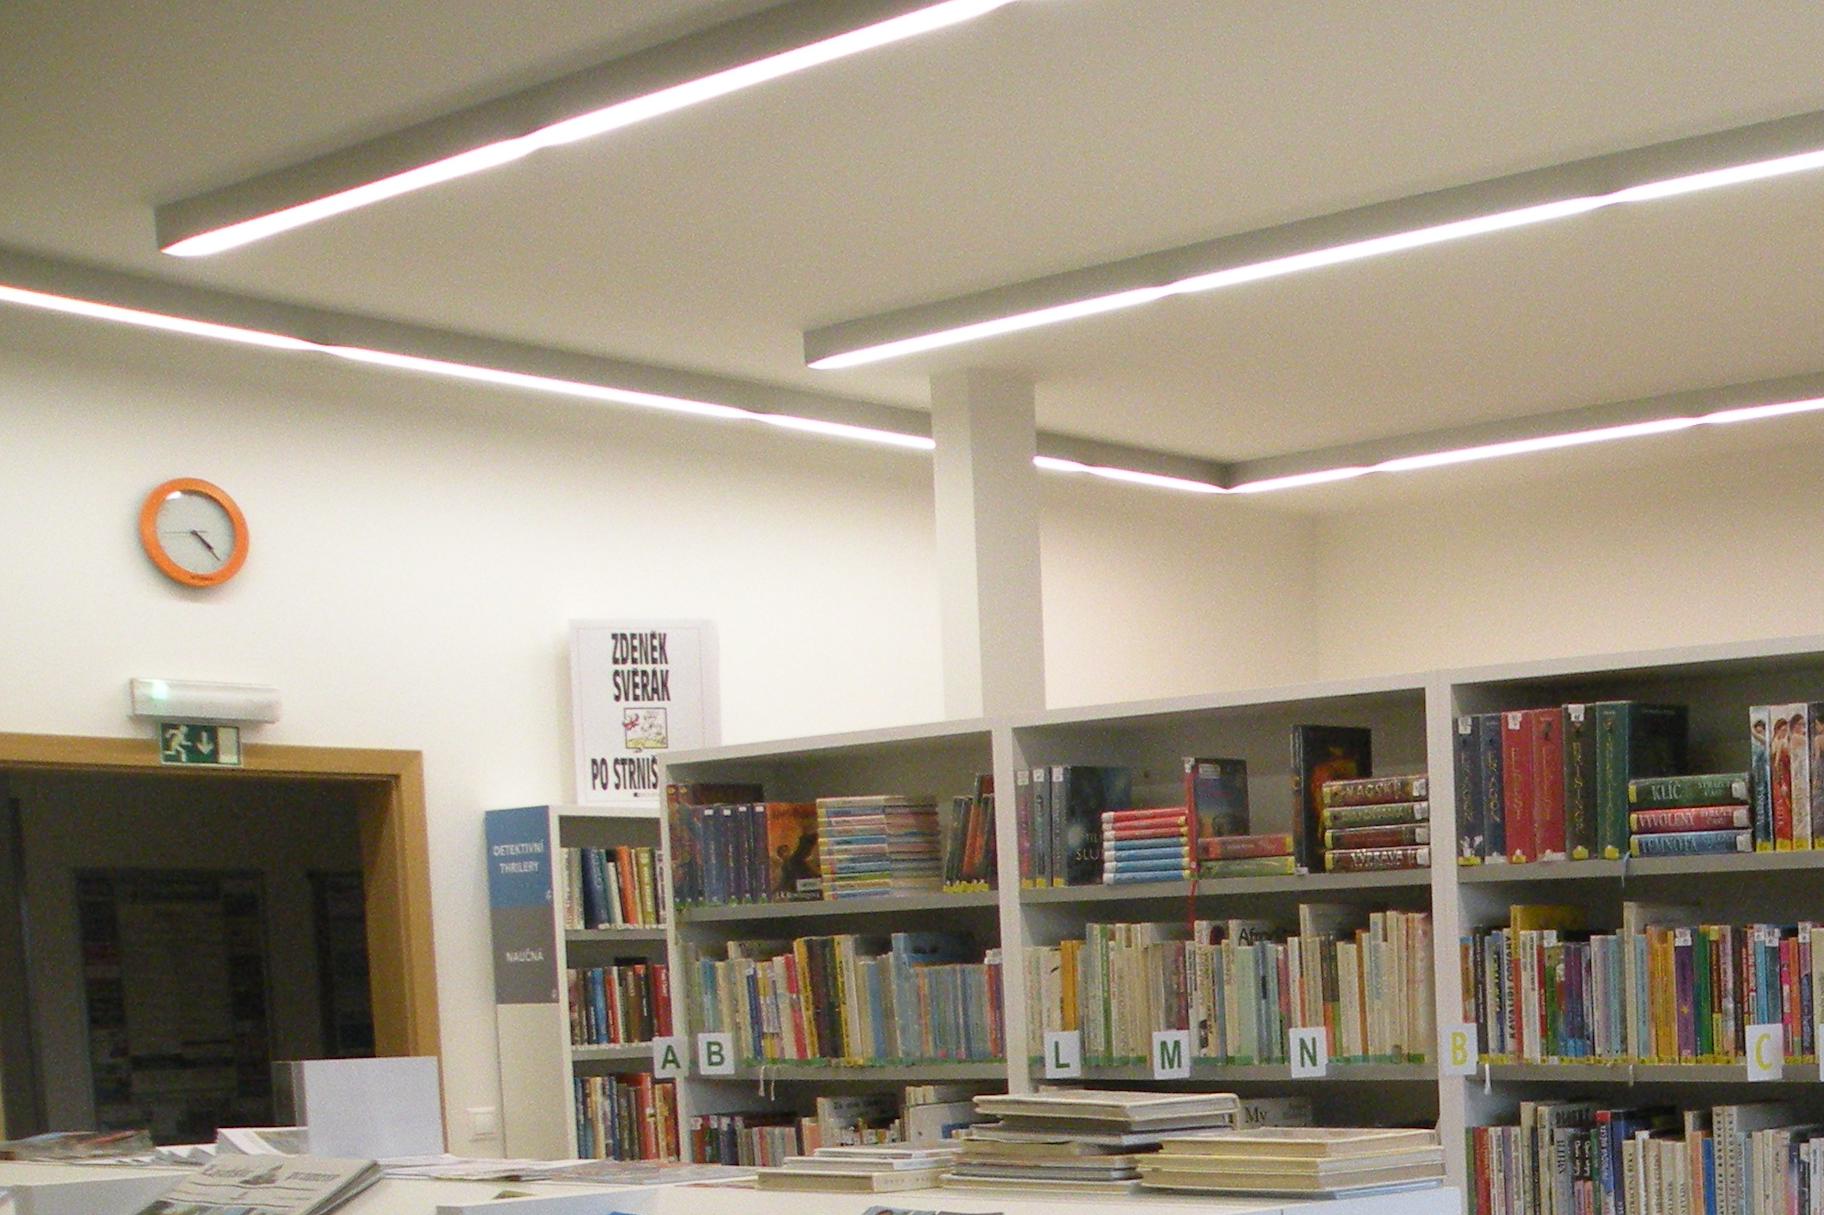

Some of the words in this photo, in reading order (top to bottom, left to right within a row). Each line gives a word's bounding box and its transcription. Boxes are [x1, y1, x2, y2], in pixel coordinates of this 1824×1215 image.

[611, 631, 669, 665] ZDENĚK
[613, 668, 671, 702] SVĚRÁK
[591, 758, 609, 790] PO
[613, 755, 659, 790] STRNIŠ
[661, 1045, 681, 1069] A
[706, 1041, 725, 1066] B
[1054, 1040, 1070, 1069] L
[1160, 1039, 1181, 1070] M
[1300, 1037, 1318, 1067] N
[1452, 1032, 1468, 1065] B
[1755, 1033, 1772, 1071] C
